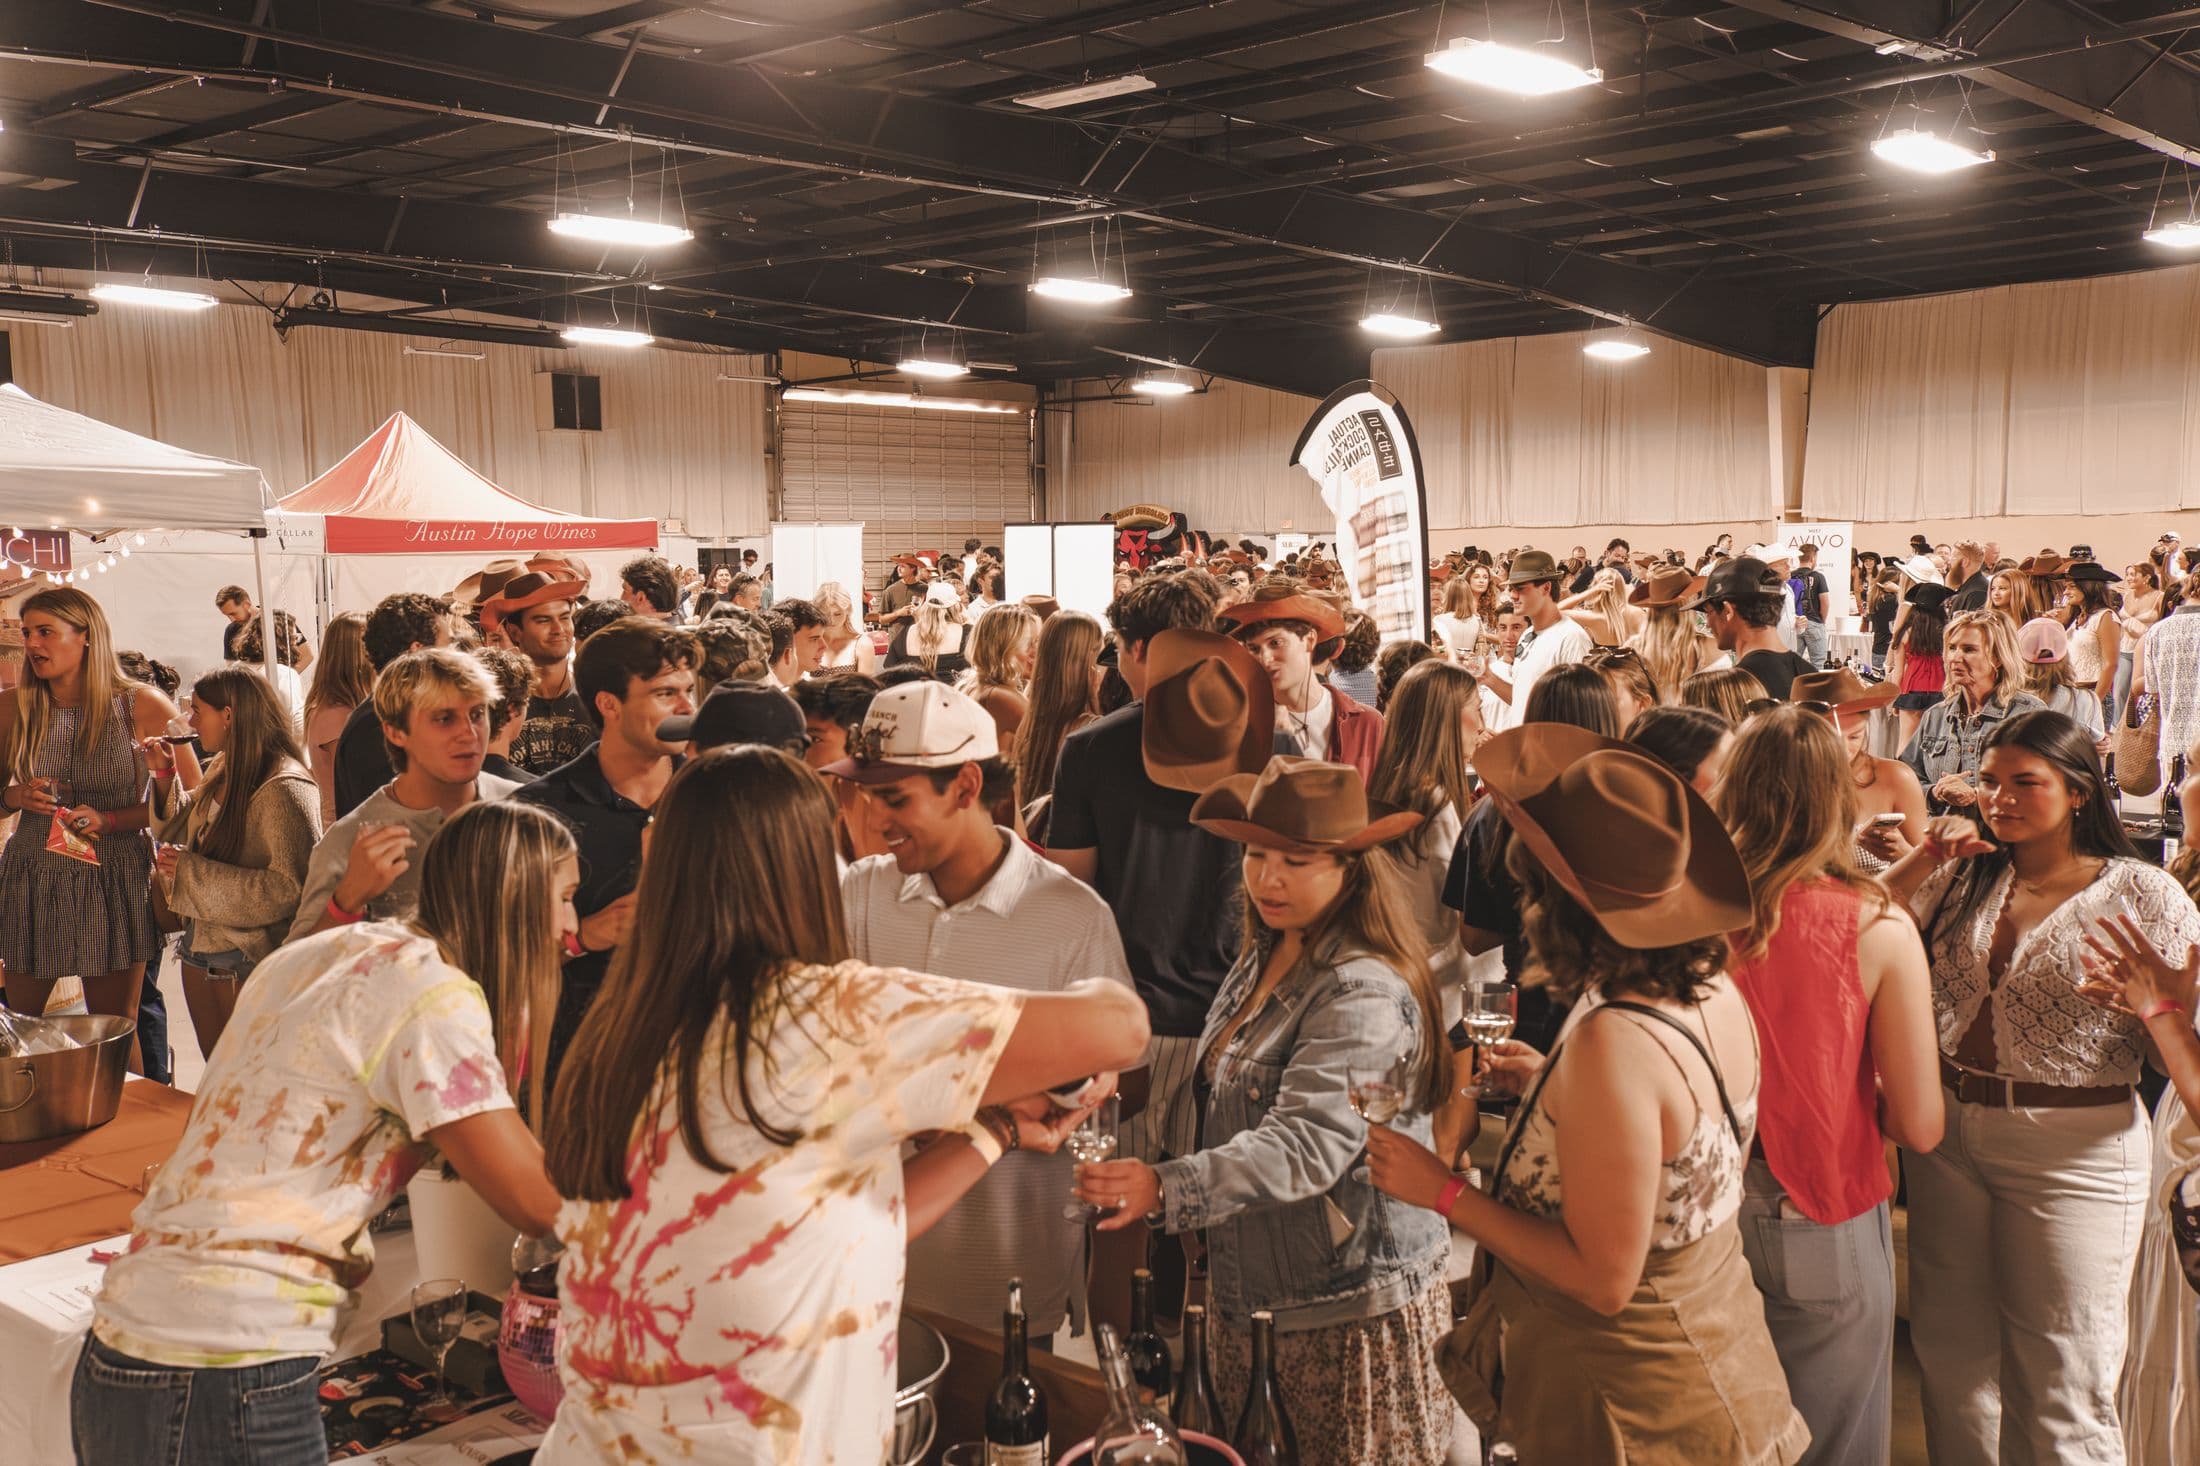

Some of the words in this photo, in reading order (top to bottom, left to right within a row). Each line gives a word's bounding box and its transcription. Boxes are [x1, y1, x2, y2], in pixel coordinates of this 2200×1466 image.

[403, 520, 476, 542] Austin
[482, 520, 538, 548] Hope
[543, 520, 598, 540] Wines
[1789, 534, 1844, 549] AVIVO
